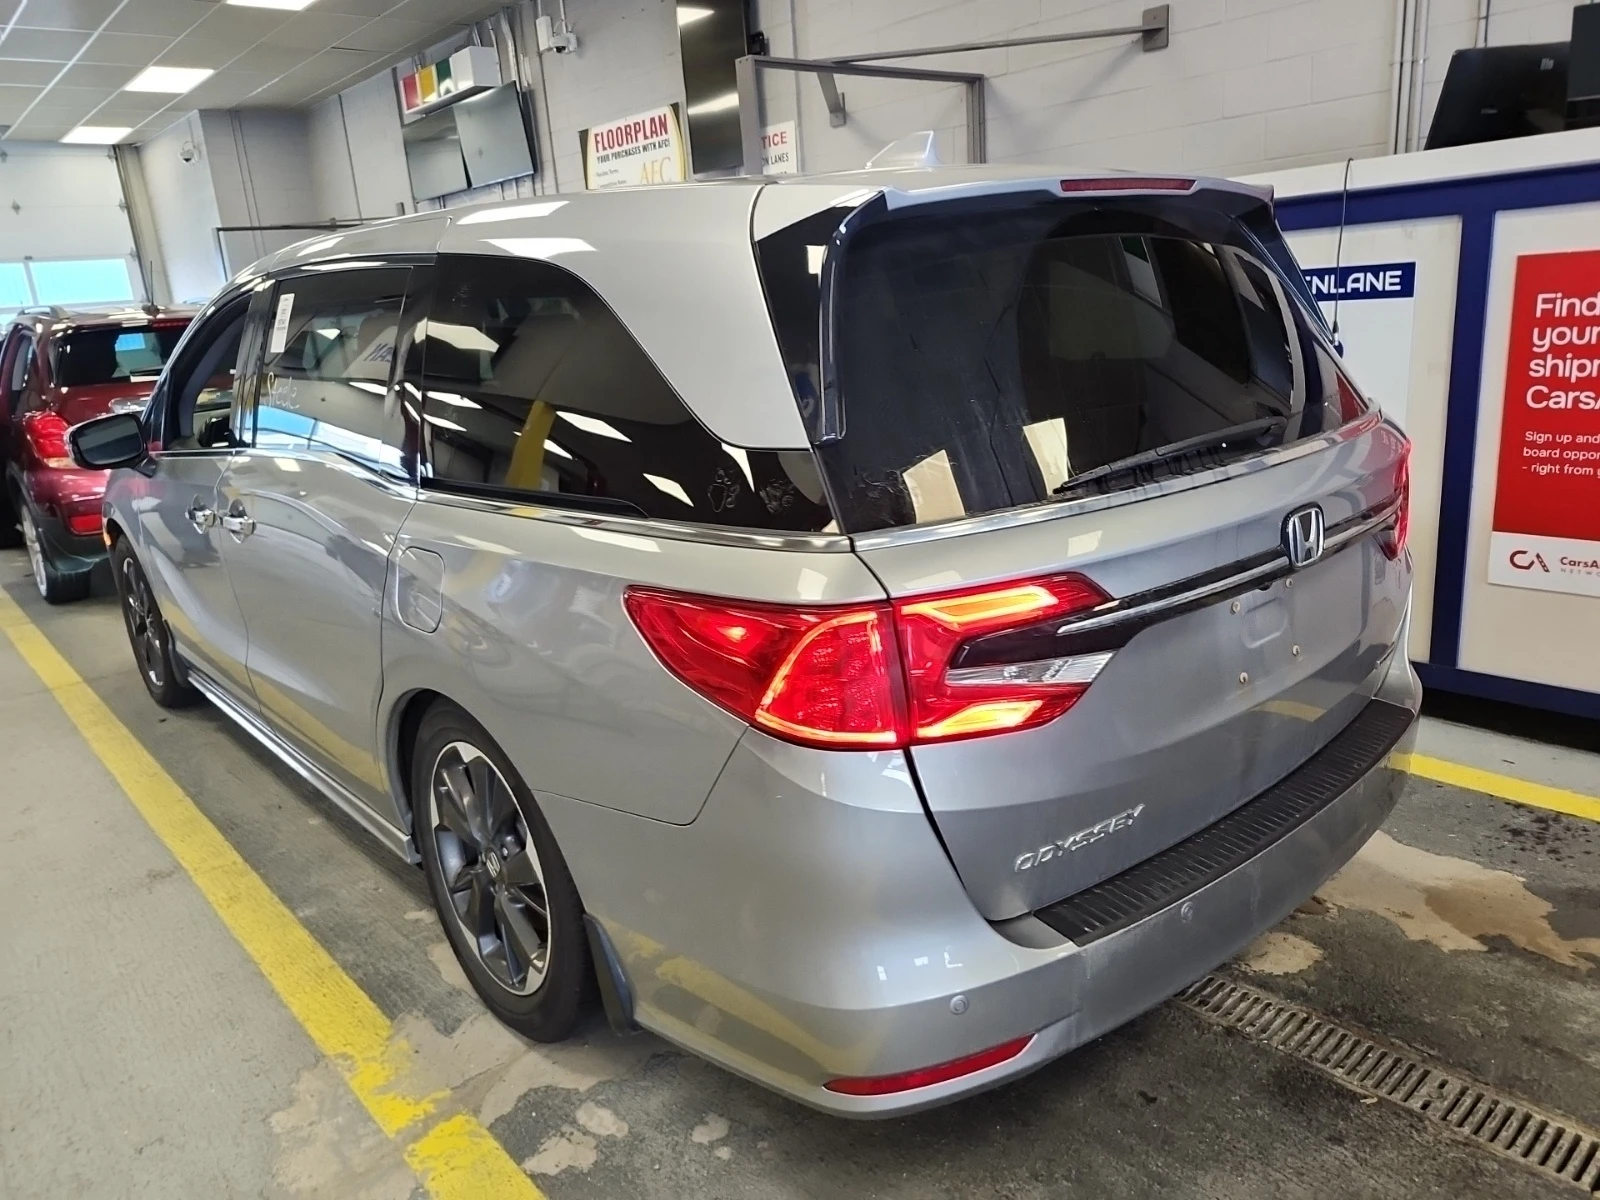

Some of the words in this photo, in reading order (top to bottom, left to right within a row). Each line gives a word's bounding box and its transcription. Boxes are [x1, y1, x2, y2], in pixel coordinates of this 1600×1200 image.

[594, 113, 668, 153] FLOORPLAN
[761, 131, 788, 150] TICE
[597, 152, 611, 164] YOUR
[611, 145, 641, 160] PURCHASES
[642, 141, 657, 153] WITH
[770, 152, 789, 165] LANES
[641, 156, 672, 185] AFC
[1305, 270, 1402, 295] NLANE
[1535, 291, 1600, 318] Find
[1525, 431, 1553, 444] Sign
[1556, 434, 1573, 444] up
[1575, 433, 1600, 444] and
[1523, 447, 1560, 458] board
[1531, 463, 1560, 476] right
[1564, 464, 1594, 475] from
[1014, 803, 1145, 873] ODYSSEY
